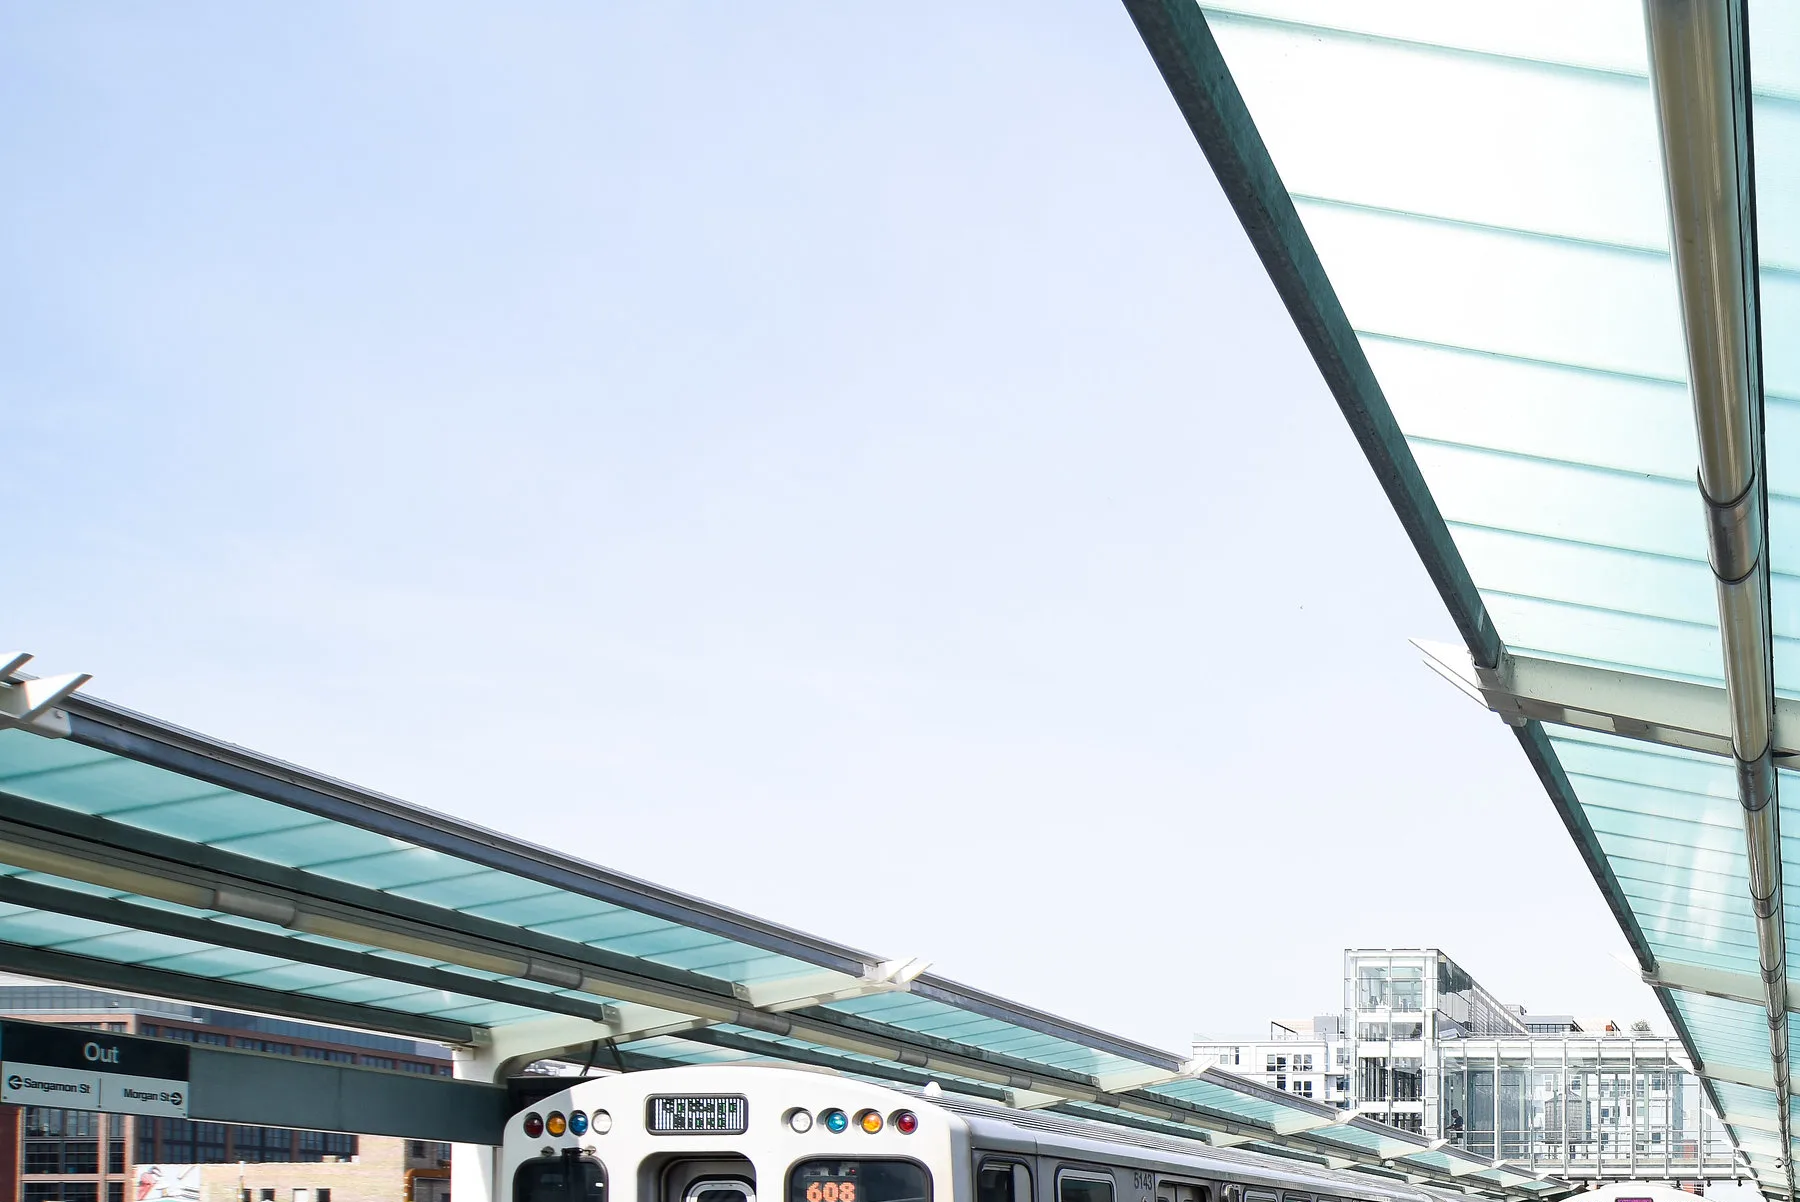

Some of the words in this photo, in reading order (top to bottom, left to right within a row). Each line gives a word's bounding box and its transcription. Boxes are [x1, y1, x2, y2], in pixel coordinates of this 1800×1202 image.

[84, 1042, 119, 1064] Out
[24, 1077, 77, 1092] Sangamon
[79, 1083, 91, 1094] St
[123, 1088, 158, 1102] Morgan
[160, 1092, 170, 1102] St
[1134, 1171, 1153, 1190] 5143
[806, 1182, 855, 1202] 608
